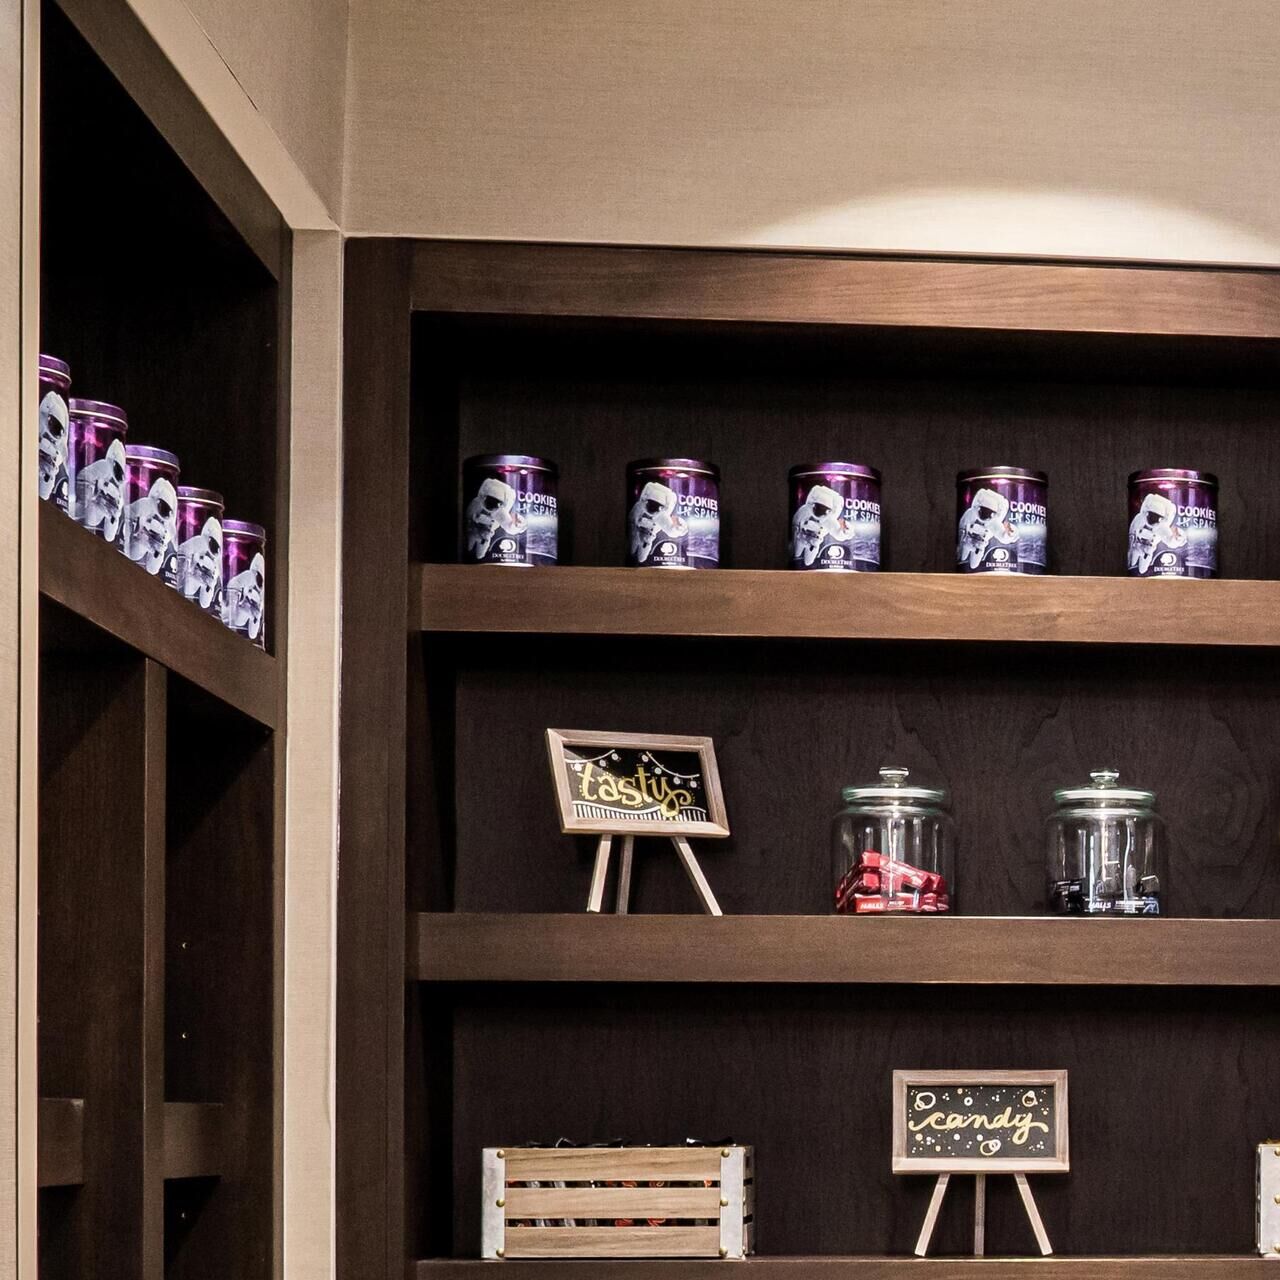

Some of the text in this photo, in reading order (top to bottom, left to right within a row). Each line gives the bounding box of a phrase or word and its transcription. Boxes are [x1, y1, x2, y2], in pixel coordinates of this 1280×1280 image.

[517, 490, 557, 508] COOKIES
[677, 494, 718, 511] COOKIES
[1177, 505, 1216, 521] COOKIES
[577, 762, 693, 817] tasty
[908, 1106, 1049, 1144] candy
